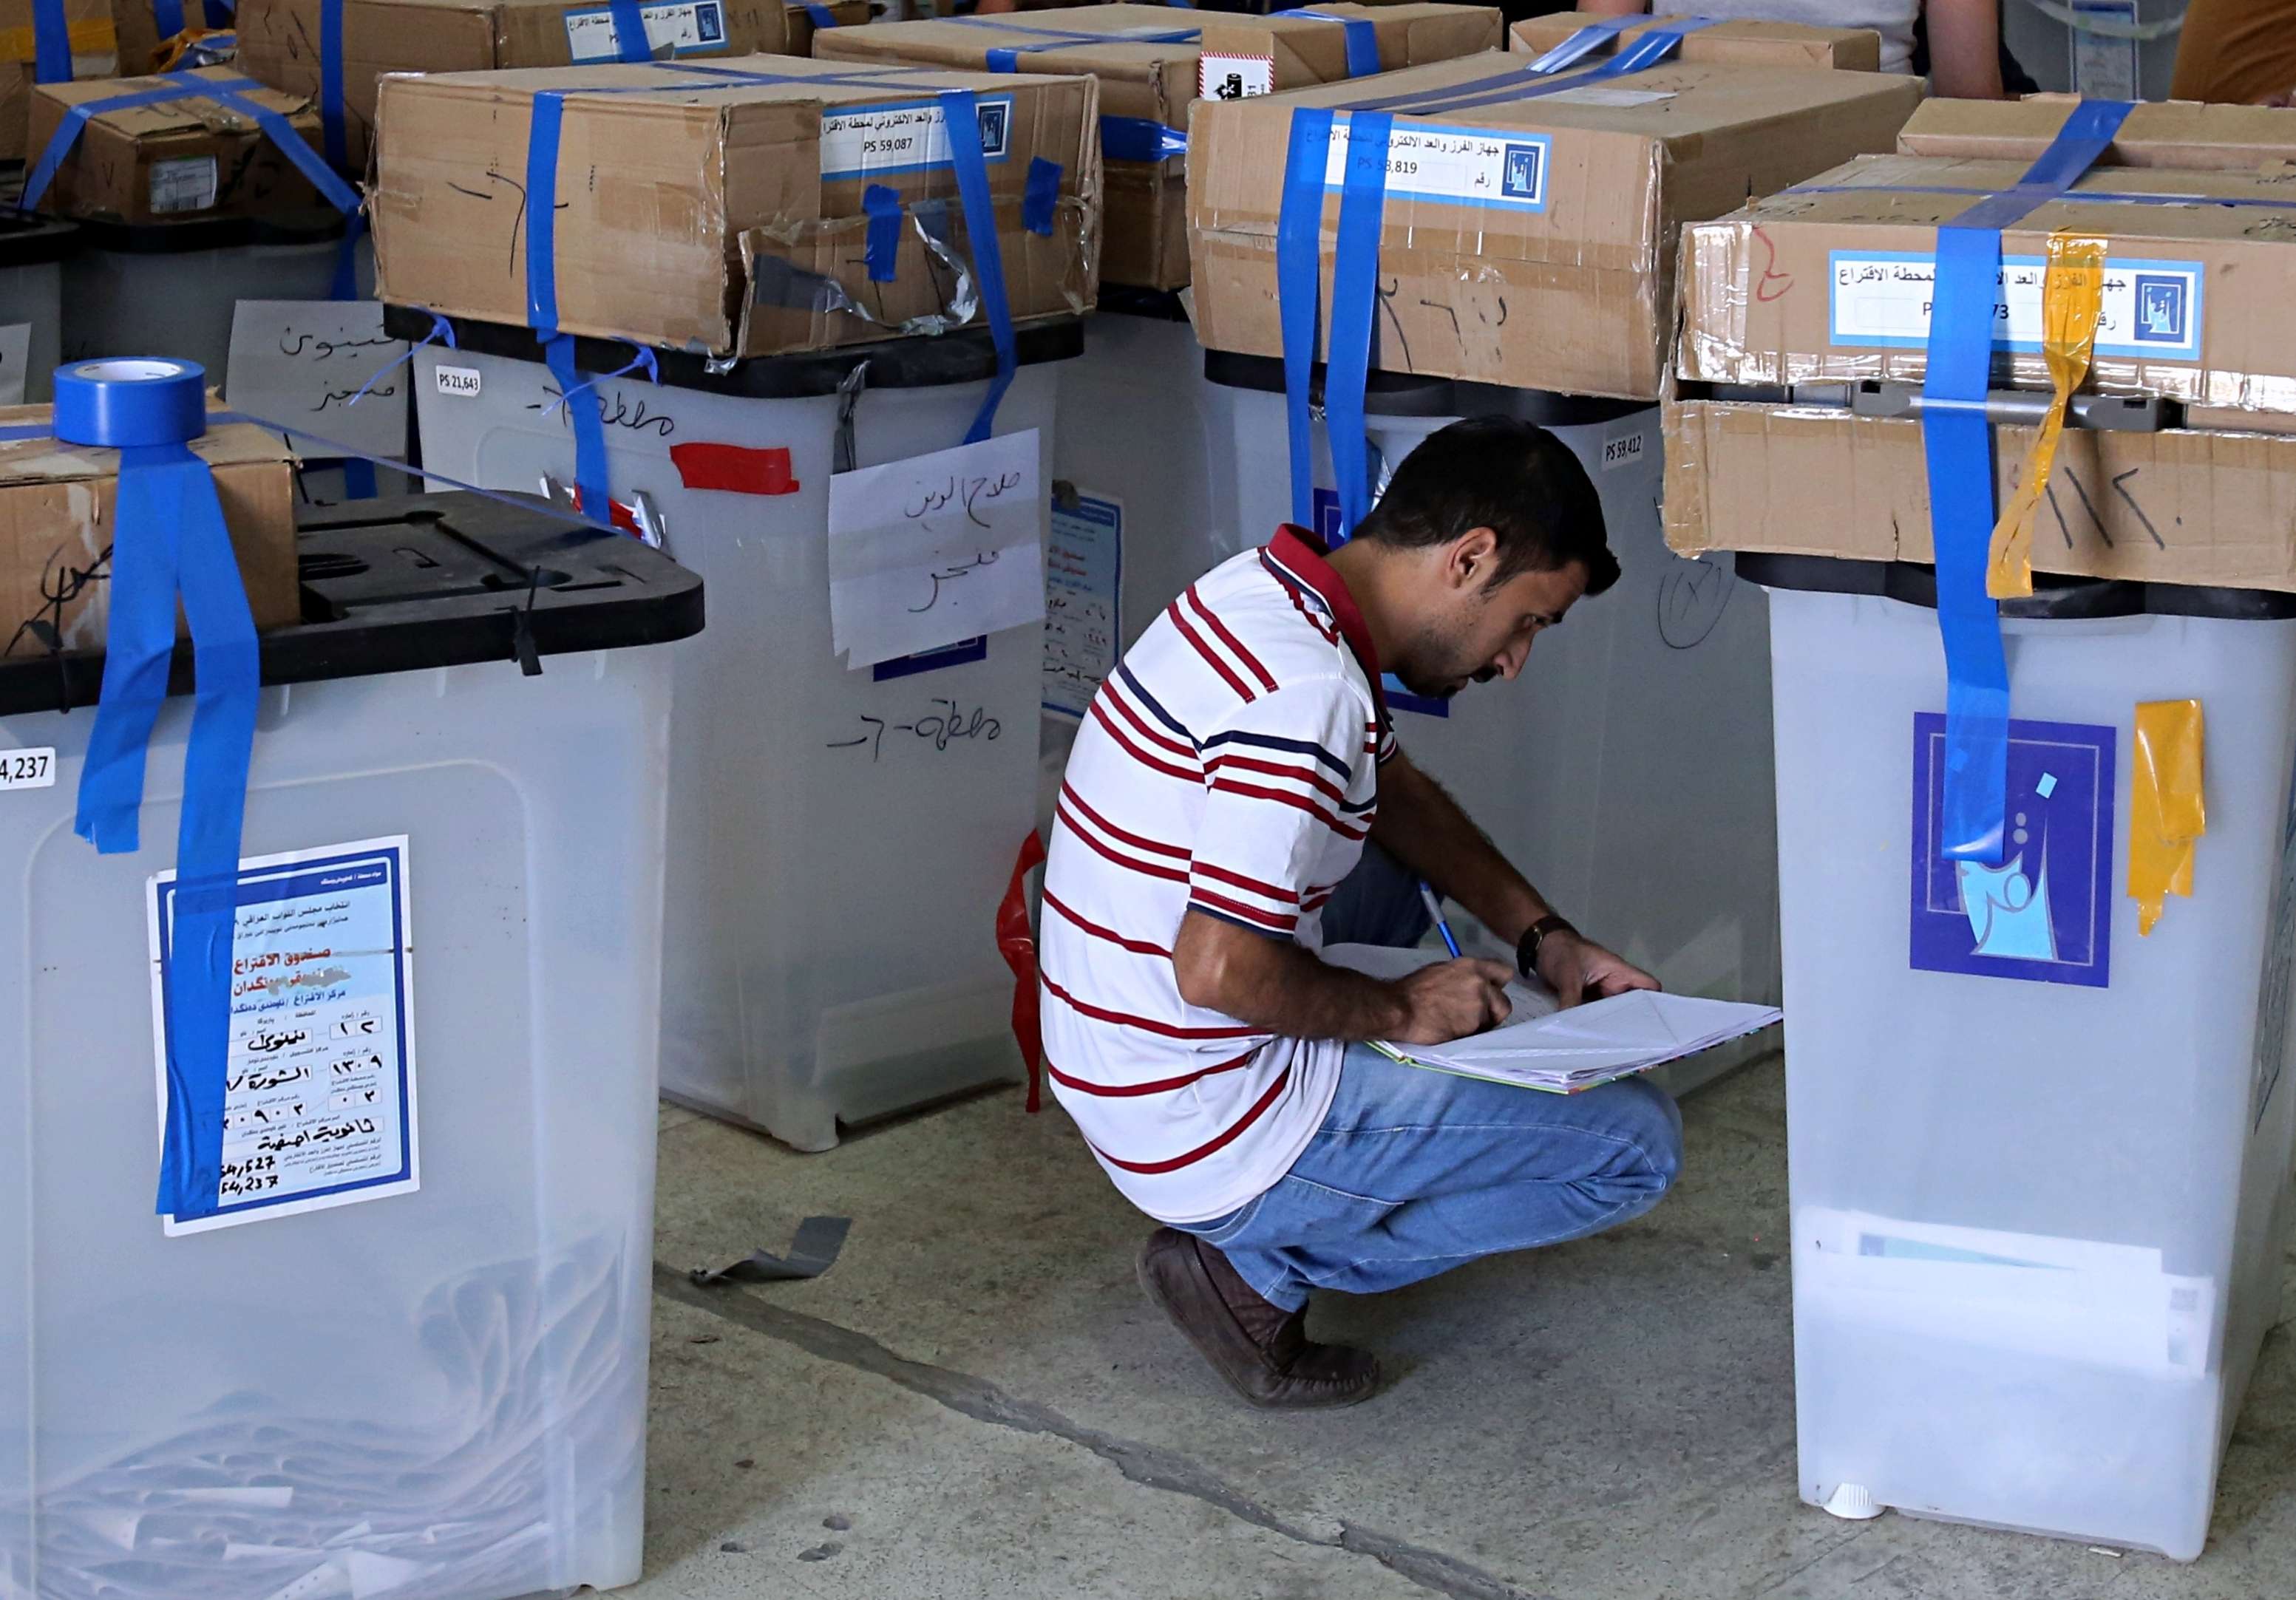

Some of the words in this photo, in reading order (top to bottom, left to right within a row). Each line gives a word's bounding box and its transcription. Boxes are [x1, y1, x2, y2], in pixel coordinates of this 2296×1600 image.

[863, 141, 877, 153] PS
[880, 137, 913, 153] 59,087
[1424, 138, 1447, 152] والعد
[1450, 140, 1473, 154] الفرز
[1476, 140, 1500, 157] جهاز
[1474, 171, 1491, 188] رقم
[1838, 266, 1889, 285] الاقتراع
[439, 373, 450, 387] PS
[452, 375, 479, 391] 21,643
[1605, 444, 1617, 462] PS
[1617, 435, 1642, 458] 59,412
[233, 952, 281, 976] الاقتراع
[283, 947, 332, 967] صندوق
[293, 991, 325, 1007] الاقتراع
[220, 1174, 279, 1196] 54,237
